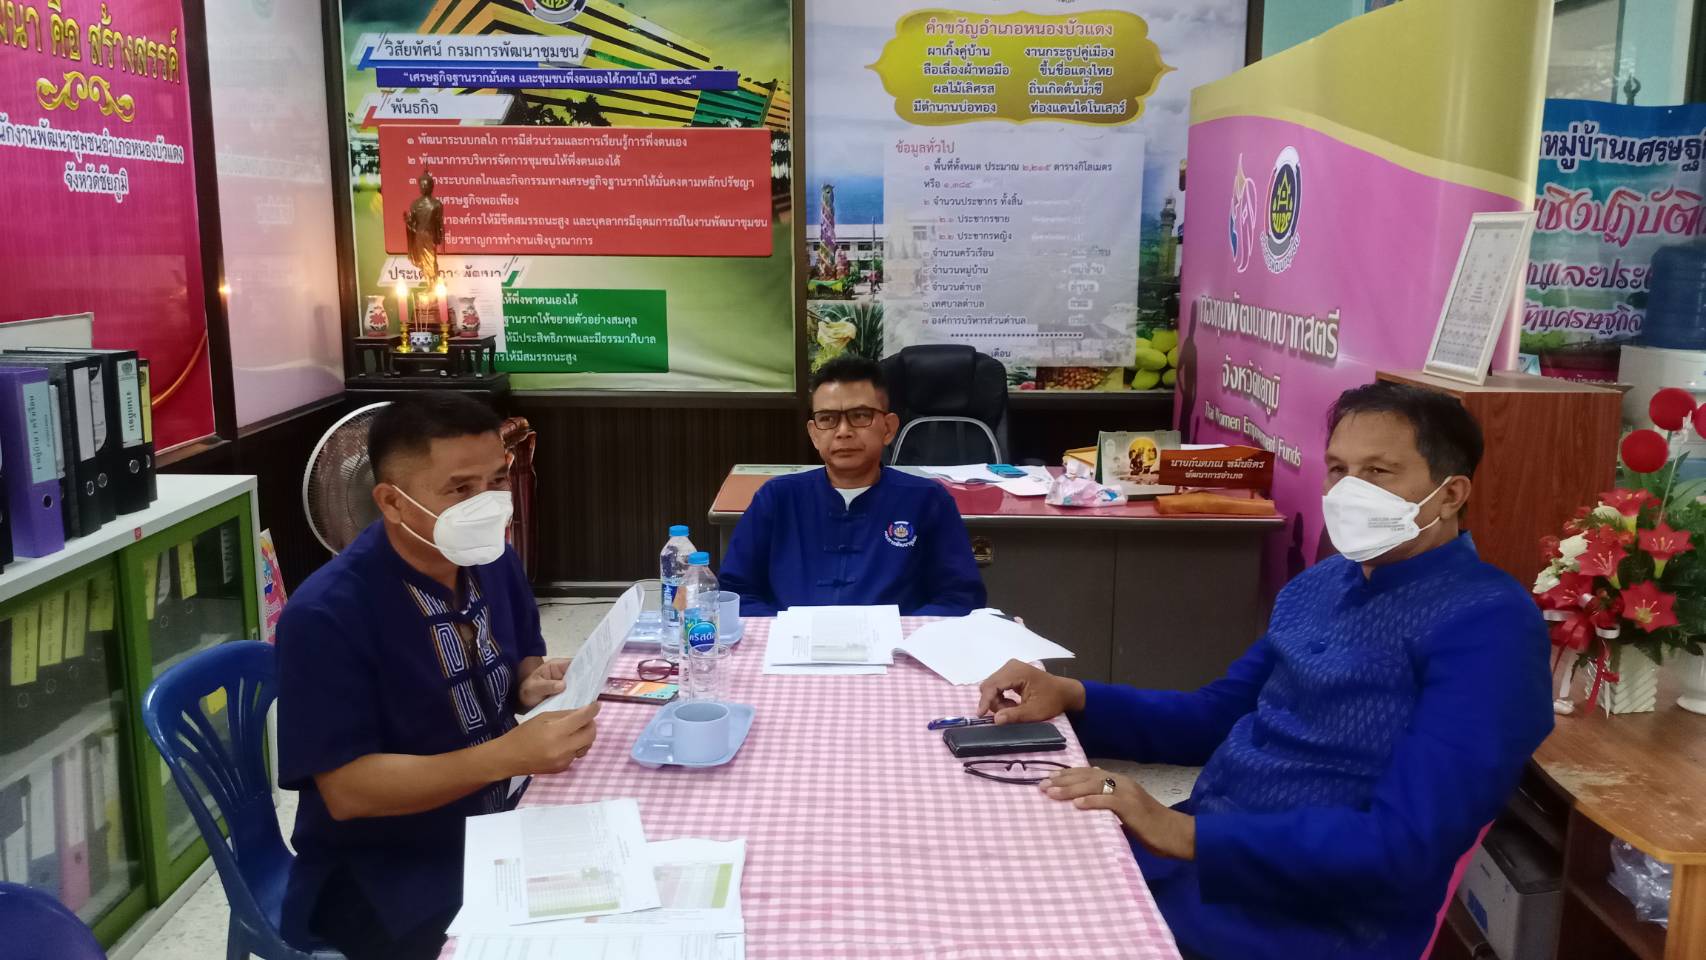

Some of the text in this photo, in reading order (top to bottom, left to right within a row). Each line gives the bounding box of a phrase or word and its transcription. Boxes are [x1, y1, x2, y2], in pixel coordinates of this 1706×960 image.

[926, 19, 1112, 39] คำขวัญอำเภอหนองบัวแดง
[88, 3, 181, 84] สร้างสรรค์
[385, 39, 579, 63] วิสัยทัศน์ กรมการพัฒนาชุมชน
[928, 41, 1113, 61] ผาเกิ้งคู่บ้าน งานกระธูปคู่เมือง
[924, 60, 1113, 76] ลือเลื่องผ้าทอมือ ขึ้นชื่อแตงไทย
[519, 71, 658, 87] และชุมชนพึ่งตนเองได้ภายในปี
[933, 79, 1102, 94] ผลไม้เลิศรส ถิ่นเกิดต้นน้ำชี
[391, 98, 439, 114] พันธกิจ
[913, 99, 996, 113] มีตำนานบ่อทอง
[418, 132, 498, 146] พัฒนาระบบกลไก
[501, 132, 688, 150] การมีส่วนร่วมและการเรียนรู้การพึ่งตนเอง
[896, 138, 955, 157] ข้อมูลทั่วไป
[985, 162, 1020, 171] ประมาณ
[1054, 160, 1112, 172] ตารางกิโลเมตร
[65, 163, 128, 202] จังหวัดชัยภูมิ
[436, 194, 519, 209] เศรษฐกิจพอเพียง
[934, 195, 998, 206] จำนวนประชากร
[958, 214, 1010, 223] ประชากรชาย
[957, 229, 1012, 243] ประชากรหญิง
[1278, 438, 1302, 467] Funds
